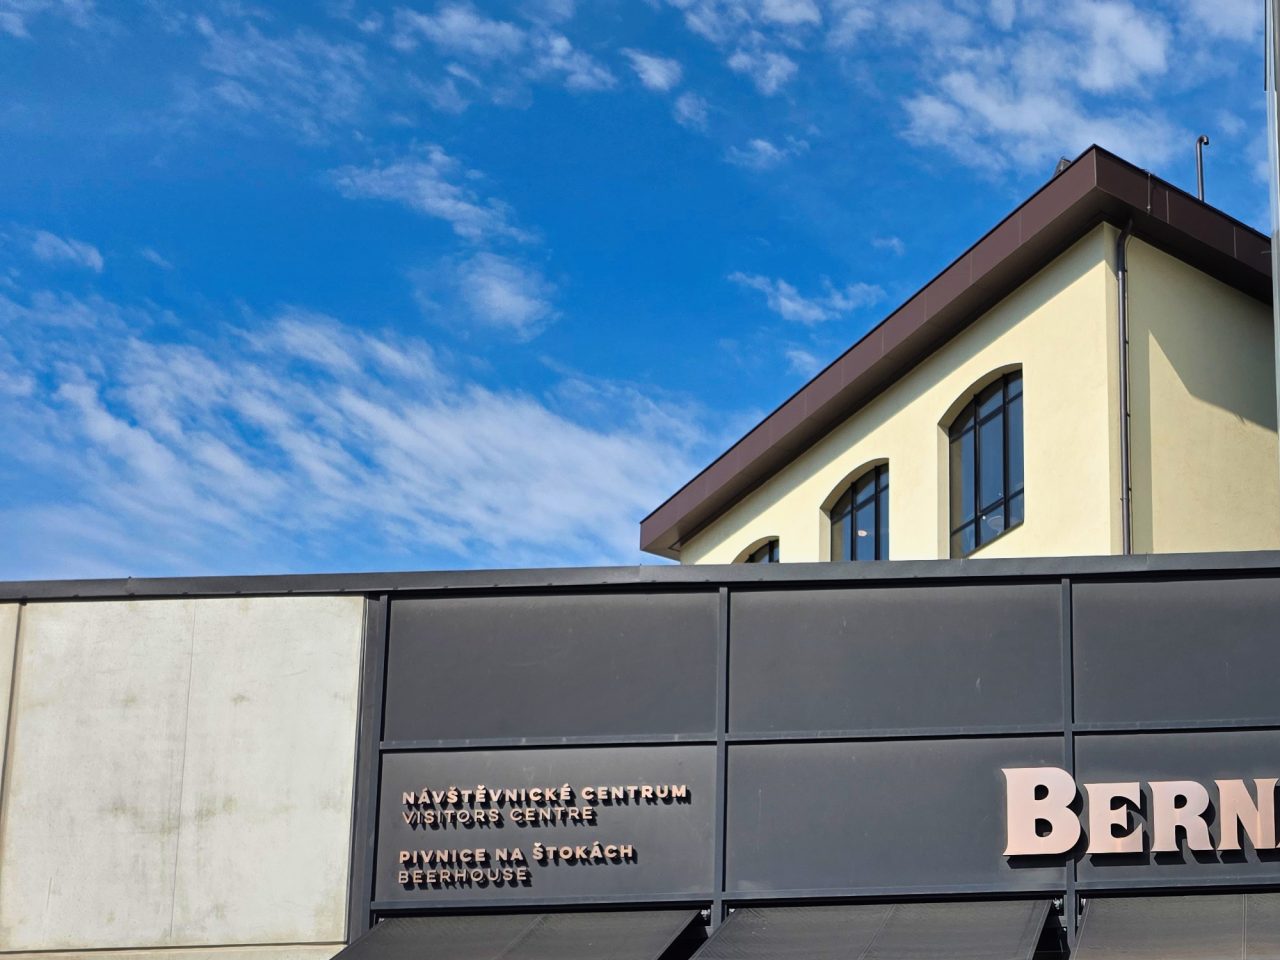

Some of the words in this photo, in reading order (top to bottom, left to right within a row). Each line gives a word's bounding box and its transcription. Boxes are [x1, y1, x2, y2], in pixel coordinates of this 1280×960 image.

[402, 783, 571, 805] NÁVŠTĚVNICKÉ
[581, 785, 687, 799] CENTRUM
[402, 808, 499, 824] VISITORS
[510, 806, 593, 821] CENTRE
[399, 848, 486, 863] PIVNICE
[495, 848, 524, 861] NA
[532, 841, 633, 860] ŠTOKÁCH
[398, 866, 528, 884] BEERHOUSE
